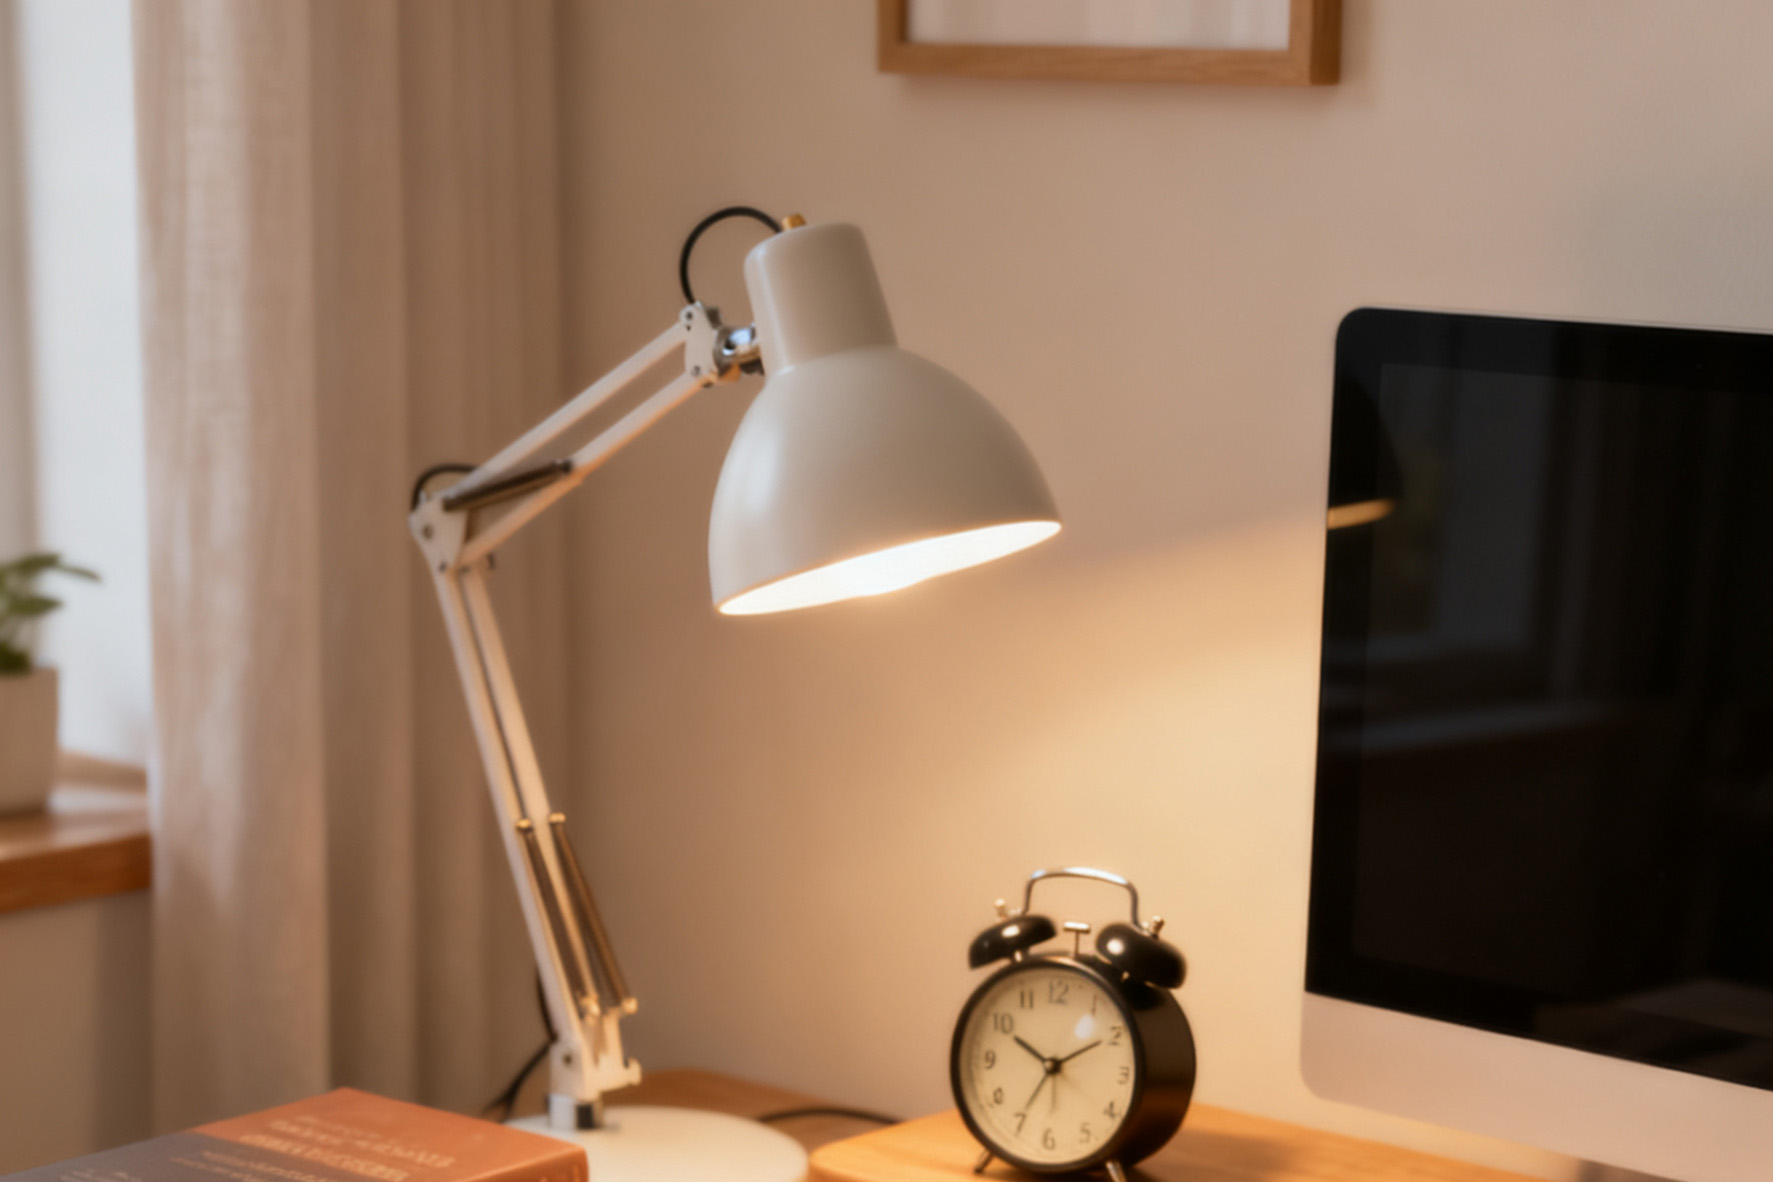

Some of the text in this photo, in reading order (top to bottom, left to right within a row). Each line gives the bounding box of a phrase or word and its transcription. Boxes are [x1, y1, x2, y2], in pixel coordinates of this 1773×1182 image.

[1019, 989, 1034, 1010] 11
[1049, 980, 1070, 1005] 12
[993, 1012, 1014, 1035] 10
[984, 1050, 996, 1070] 9
[1042, 1127, 1055, 1150] 6
